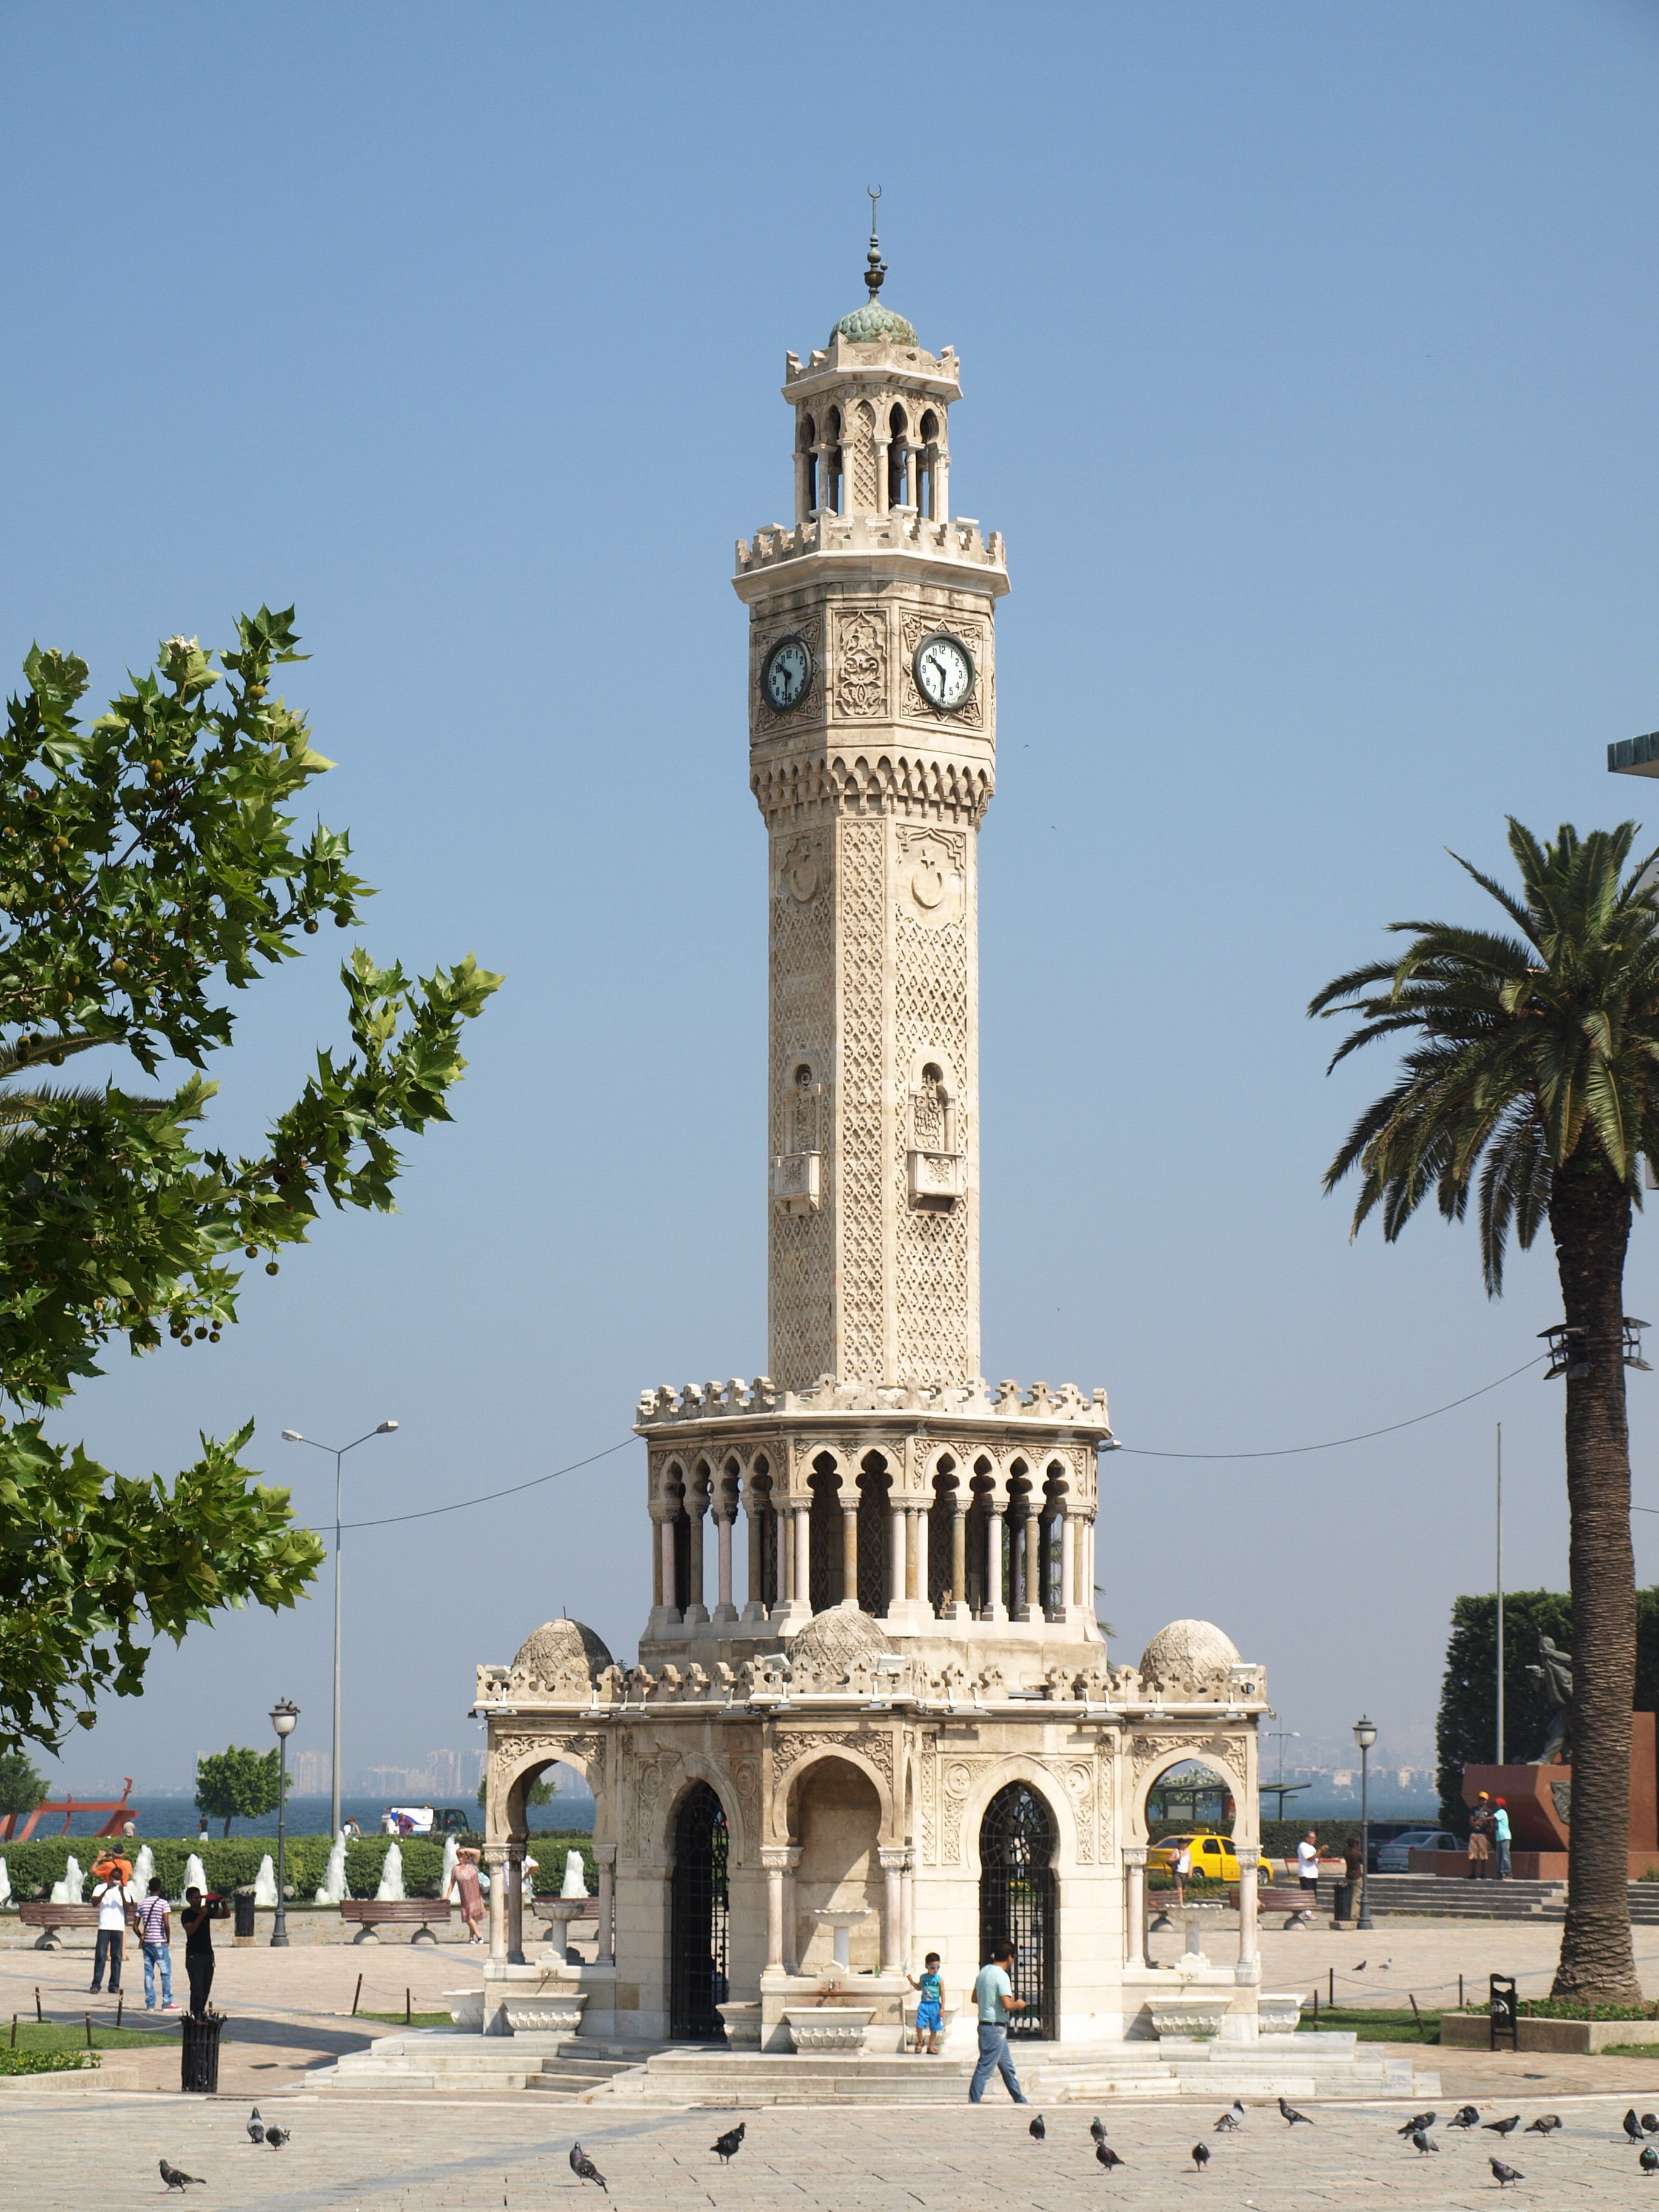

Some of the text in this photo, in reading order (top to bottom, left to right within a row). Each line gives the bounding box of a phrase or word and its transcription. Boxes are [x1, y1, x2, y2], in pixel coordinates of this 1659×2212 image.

[933, 648, 937, 656] 11
[939, 645, 945, 654] 12
[786, 650, 792, 659] 12
[926, 655, 933, 663] 10
[781, 655, 785, 665] 11
[800, 656, 803, 665] 2
[956, 658, 959, 666] 2
[959, 670, 962, 679] 3
[773, 676, 776, 685] 9
[927, 677, 930, 686] 8
[956, 682, 959, 690] 4
[776, 687, 780, 695] 8
[781, 691, 785, 700] 7
[950, 687, 953, 695] 5
